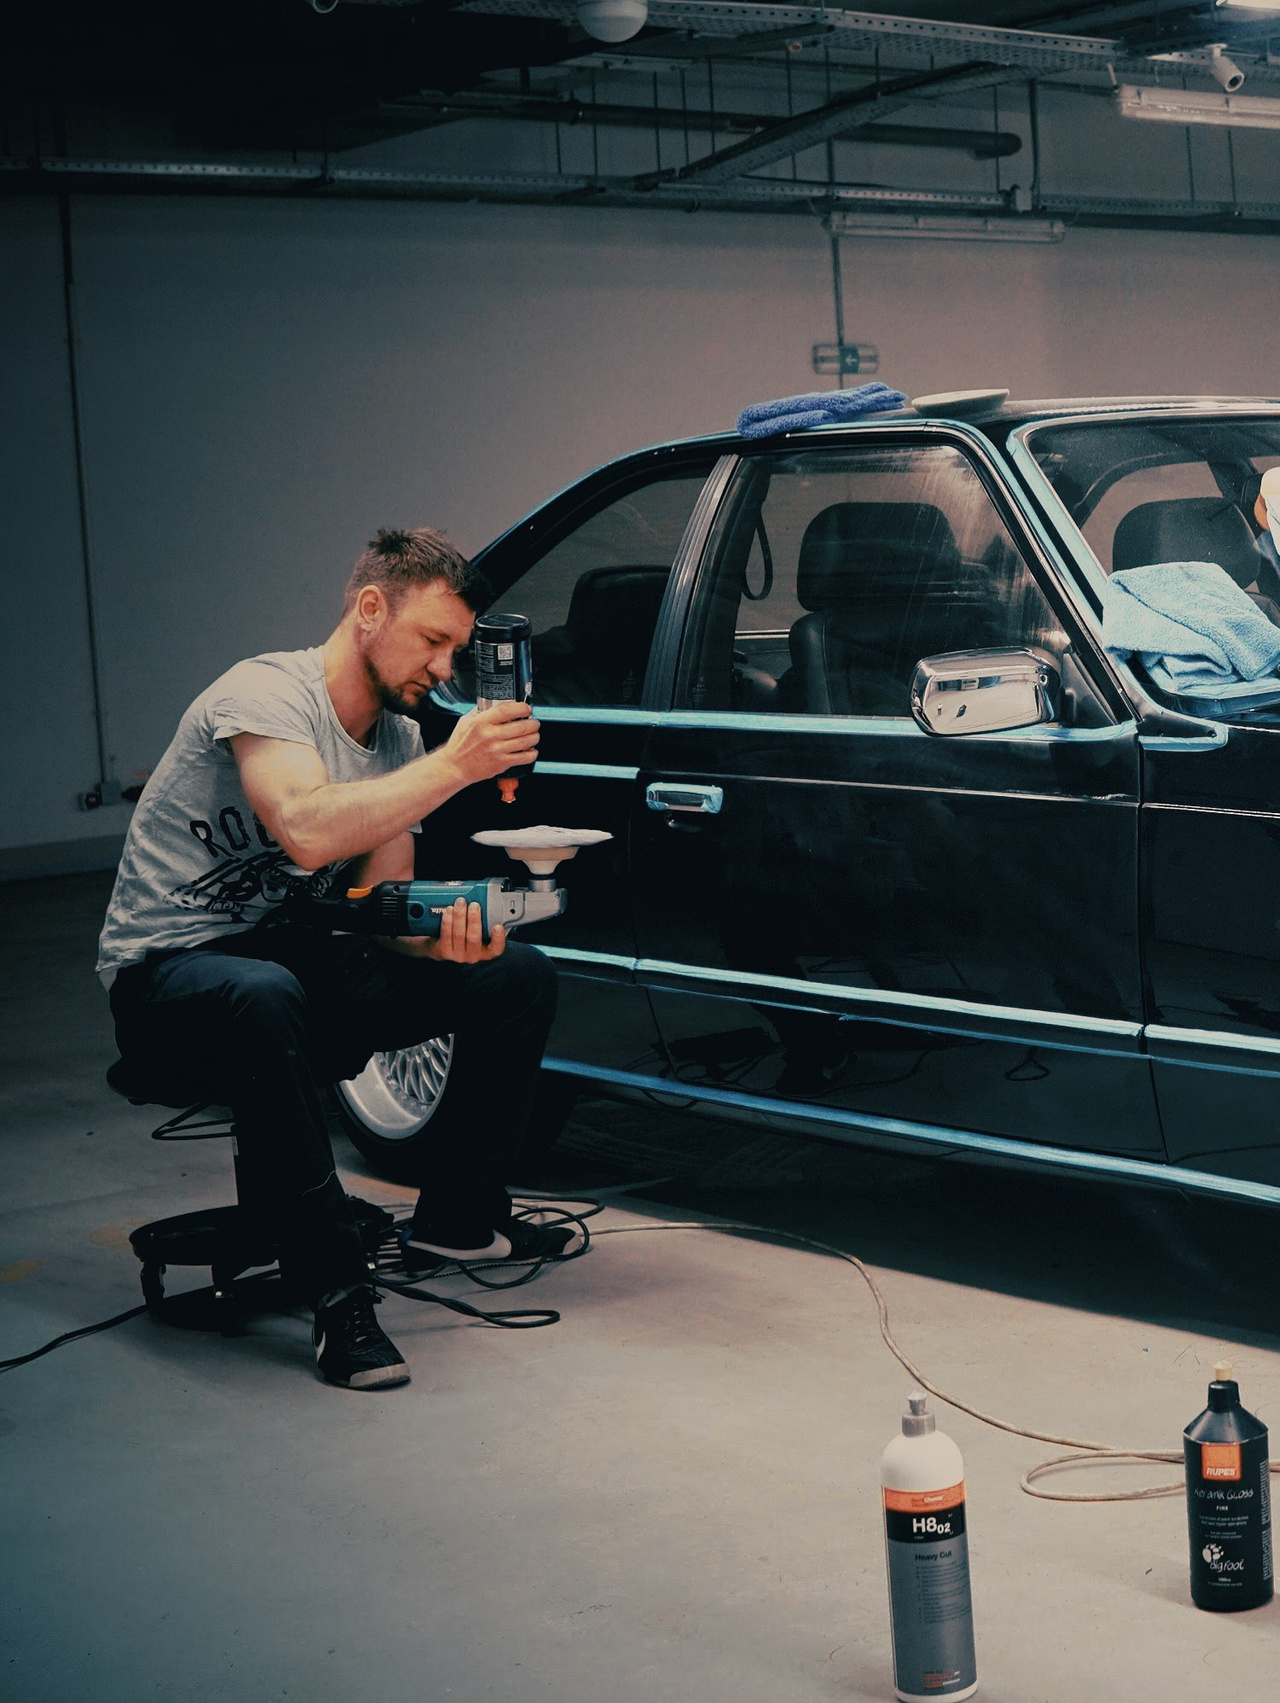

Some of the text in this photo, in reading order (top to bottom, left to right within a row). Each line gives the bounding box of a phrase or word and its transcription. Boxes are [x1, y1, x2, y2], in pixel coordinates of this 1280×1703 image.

[1206, 1467, 1236, 1476] RUPES
[914, 1550, 952, 1561] Heavy Cut
